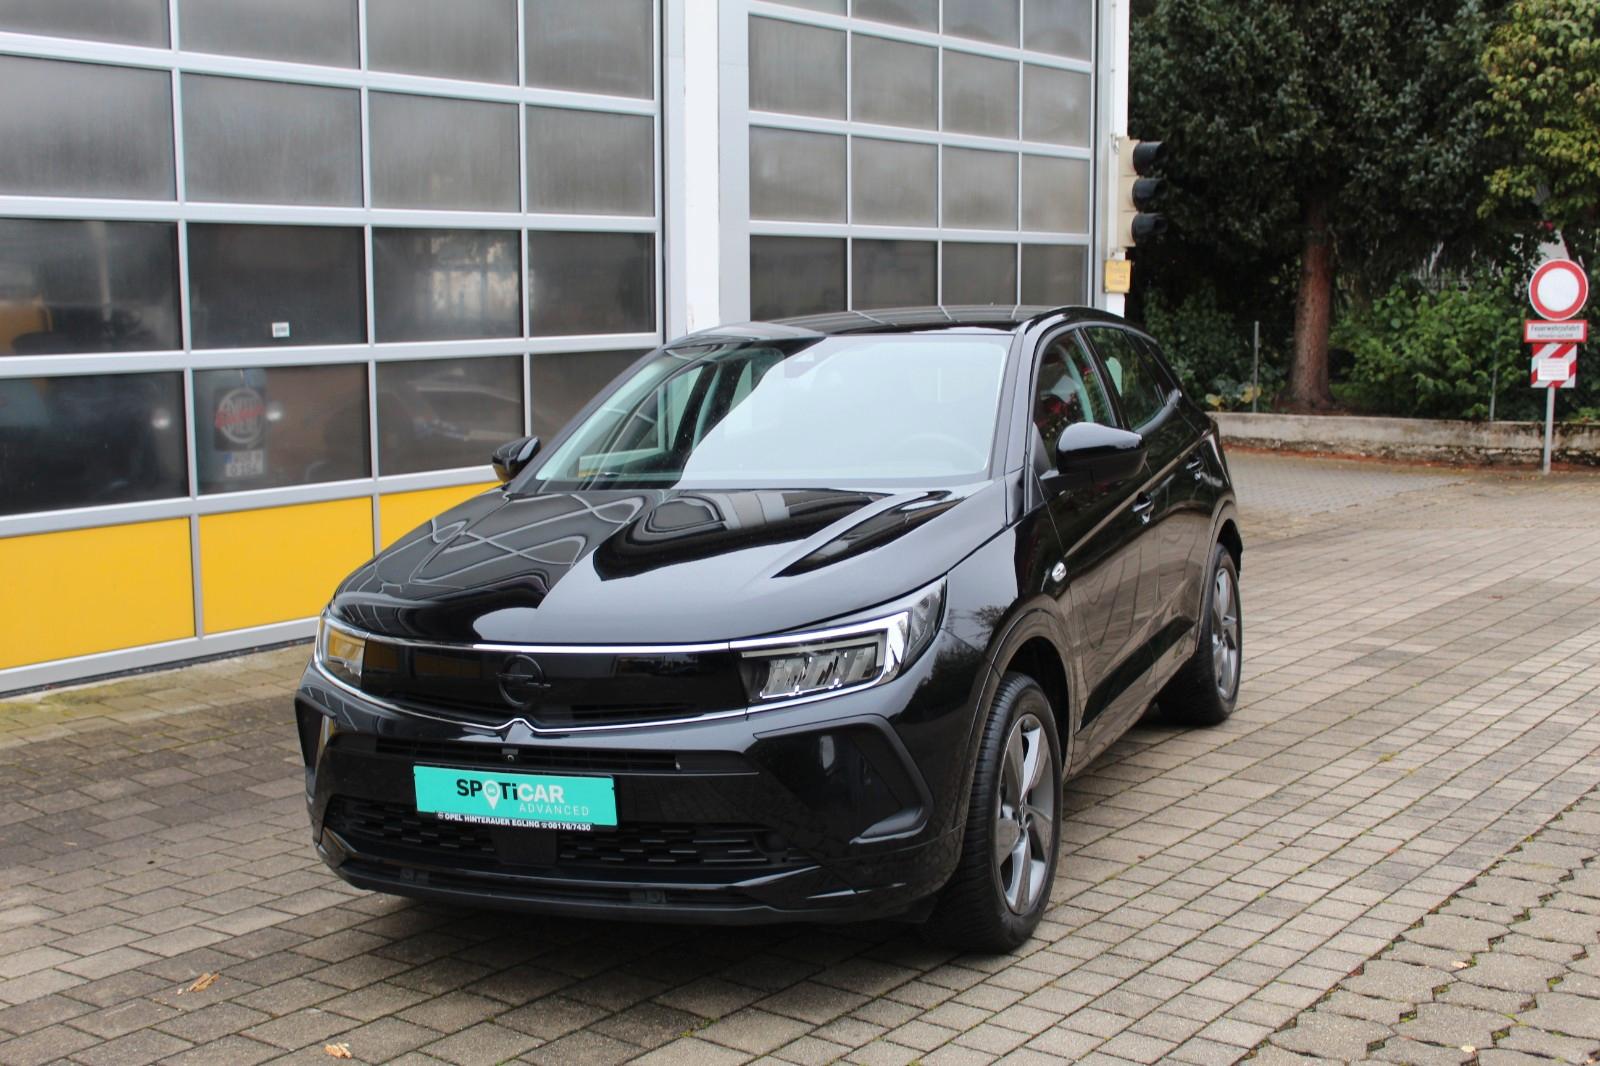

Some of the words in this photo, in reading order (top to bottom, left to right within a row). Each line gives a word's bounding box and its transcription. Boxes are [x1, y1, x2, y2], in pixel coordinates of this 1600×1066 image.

[519, 803, 590, 816] ADVANCED
[444, 813, 463, 822] OPEL
[464, 814, 511, 826] HINTERAUER
[511, 818, 541, 829] EGLING
